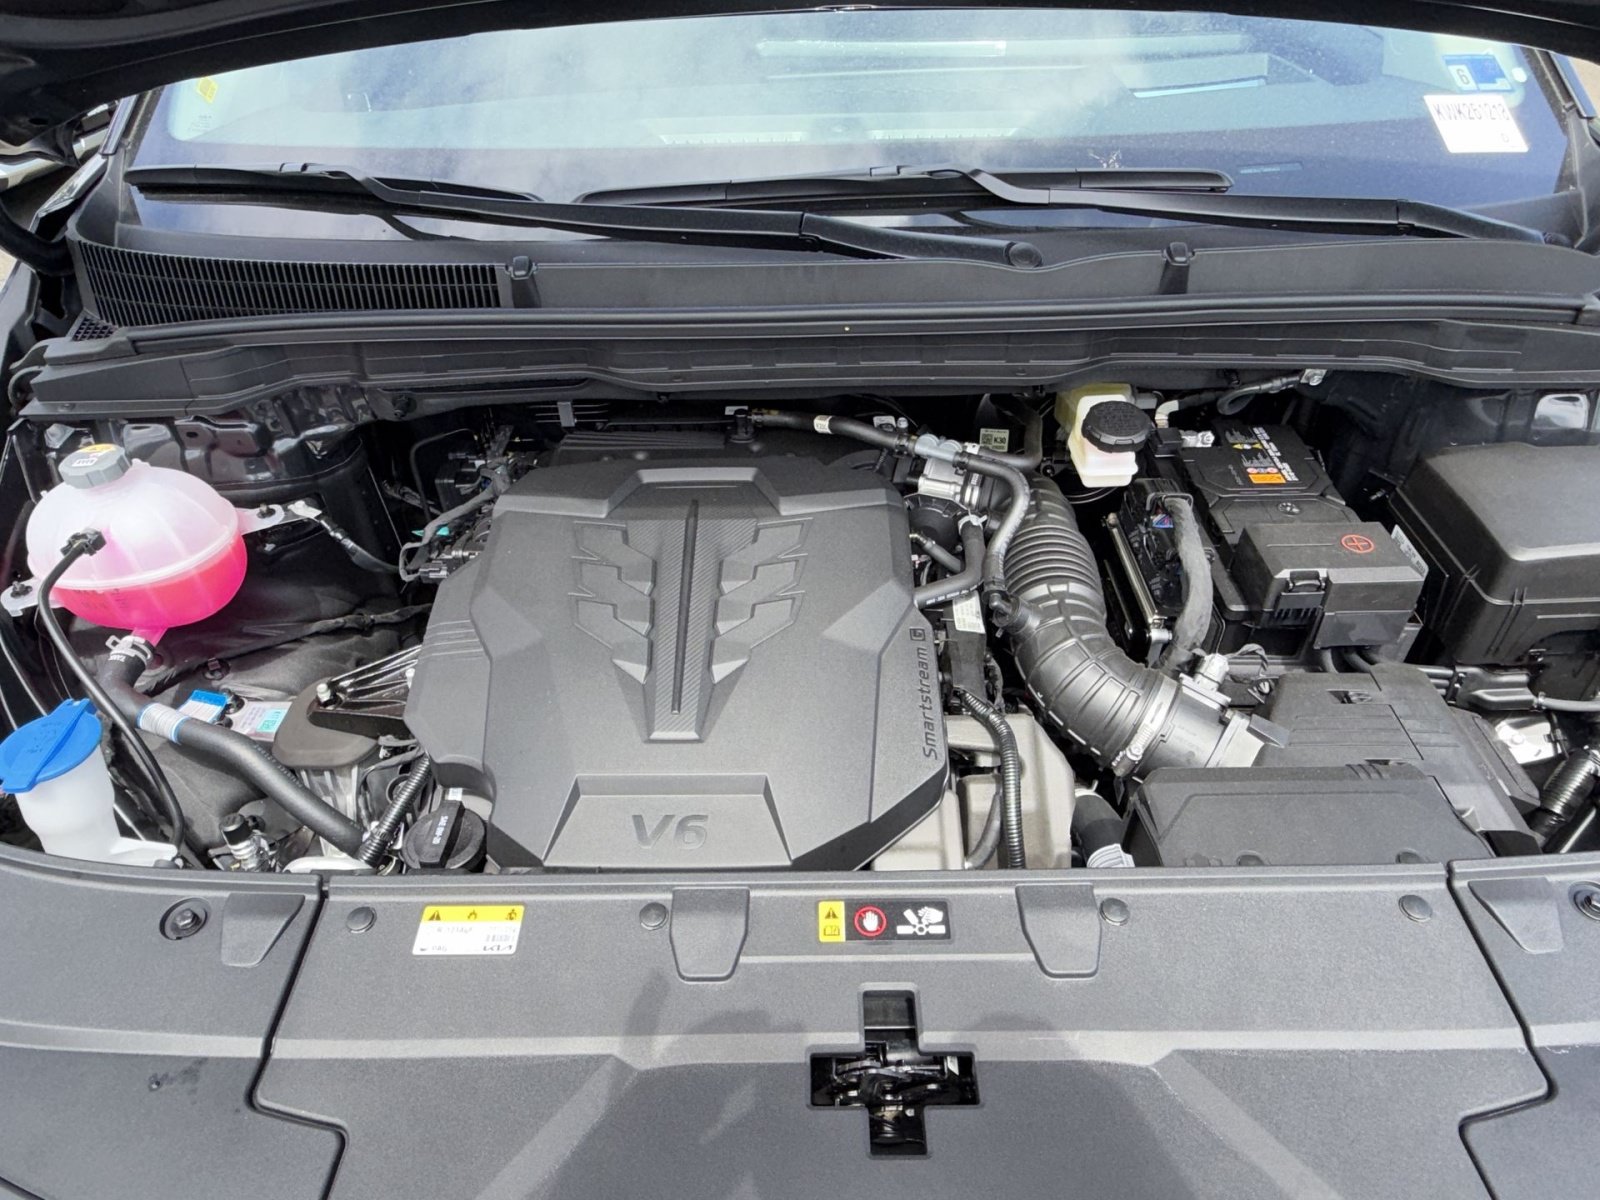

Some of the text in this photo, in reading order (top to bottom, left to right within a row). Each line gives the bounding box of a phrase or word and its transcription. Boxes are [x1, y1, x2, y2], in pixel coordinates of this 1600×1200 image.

[1456, 68, 1470, 85] 6
[916, 647, 938, 761] Smartstream
[631, 814, 709, 849] V6
